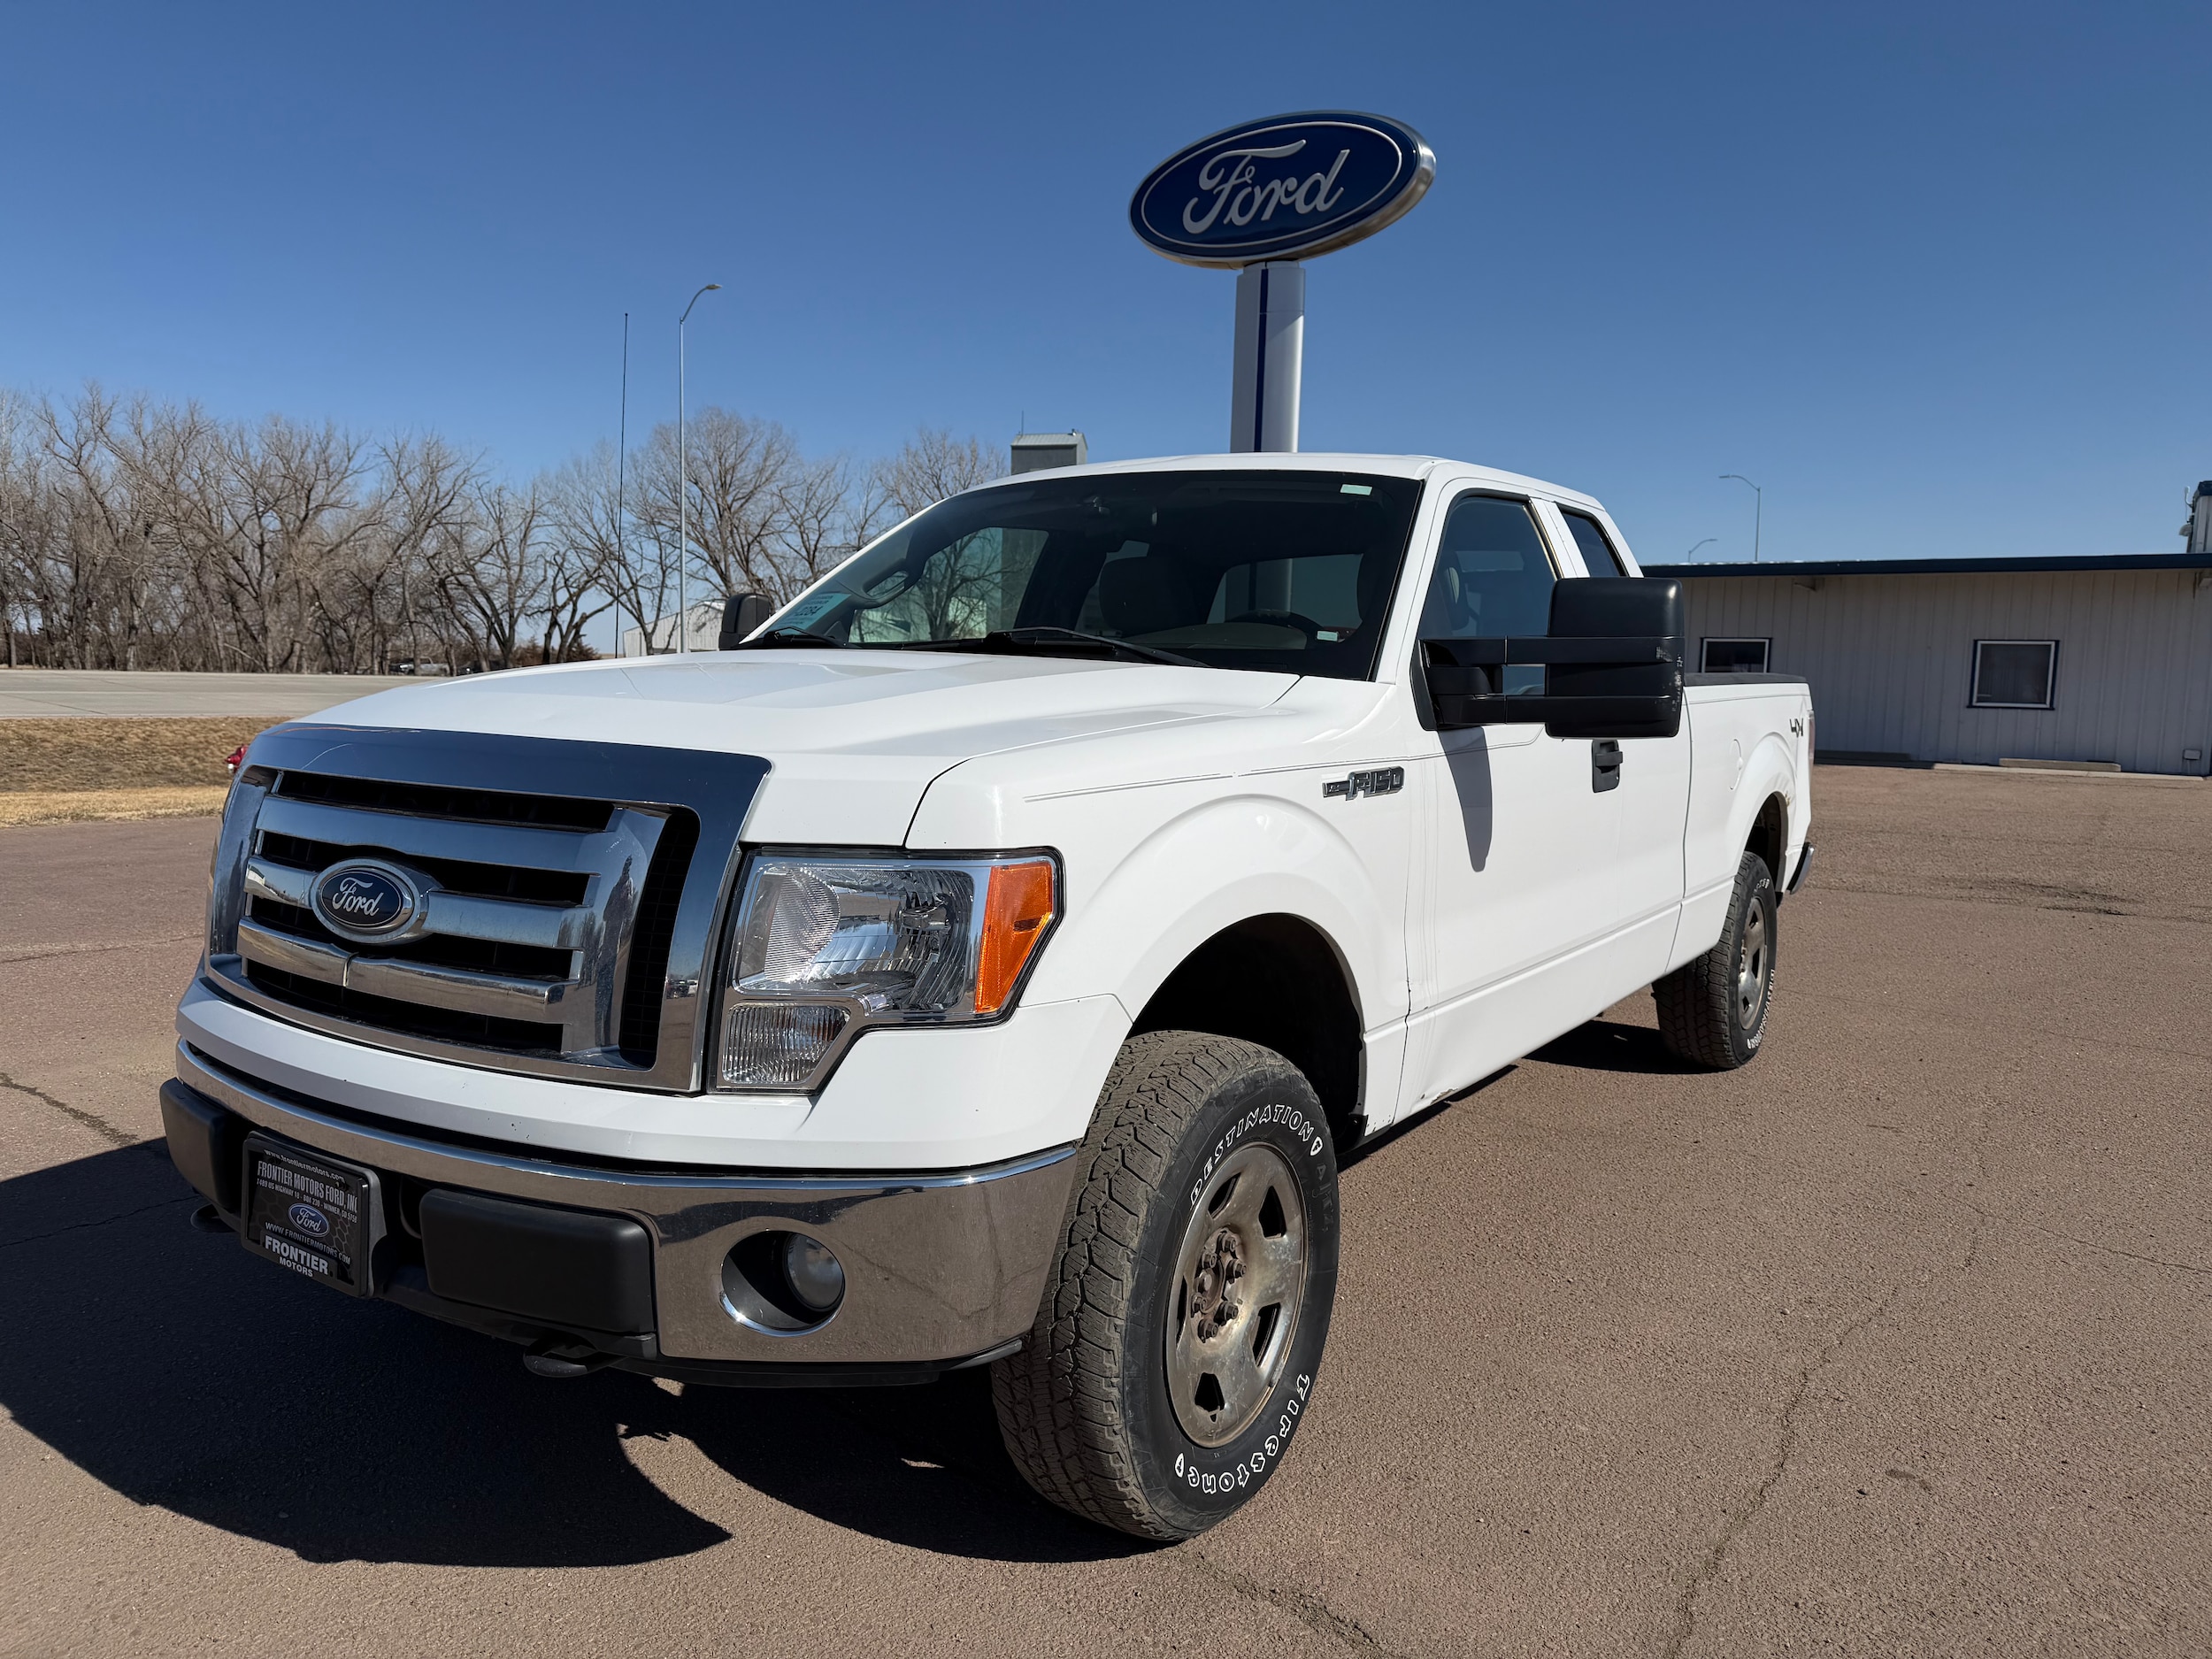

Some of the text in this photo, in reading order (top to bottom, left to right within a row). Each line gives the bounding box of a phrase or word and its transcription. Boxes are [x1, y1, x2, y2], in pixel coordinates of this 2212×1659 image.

[1181, 139, 1351, 234] Ford
[332, 877, 384, 917] Ford
[264, 1149, 346, 1183] www.frontiermotors.com
[1189, 1103, 1315, 1206] DESTINATION
[257, 1160, 293, 1187] FRONTIER
[294, 1173, 325, 1199] MOTORS
[268, 1181, 274, 1190] US
[275, 1184, 294, 1196] HIGHWAY
[303, 1194, 312, 1203] BOX
[296, 1208, 322, 1232] Ford
[265, 1221, 351, 1265] WWW.FRONTIERMOTORSCOM
[265, 1235, 329, 1276] FRONTIER
[279, 1256, 314, 1278] MOTORS
